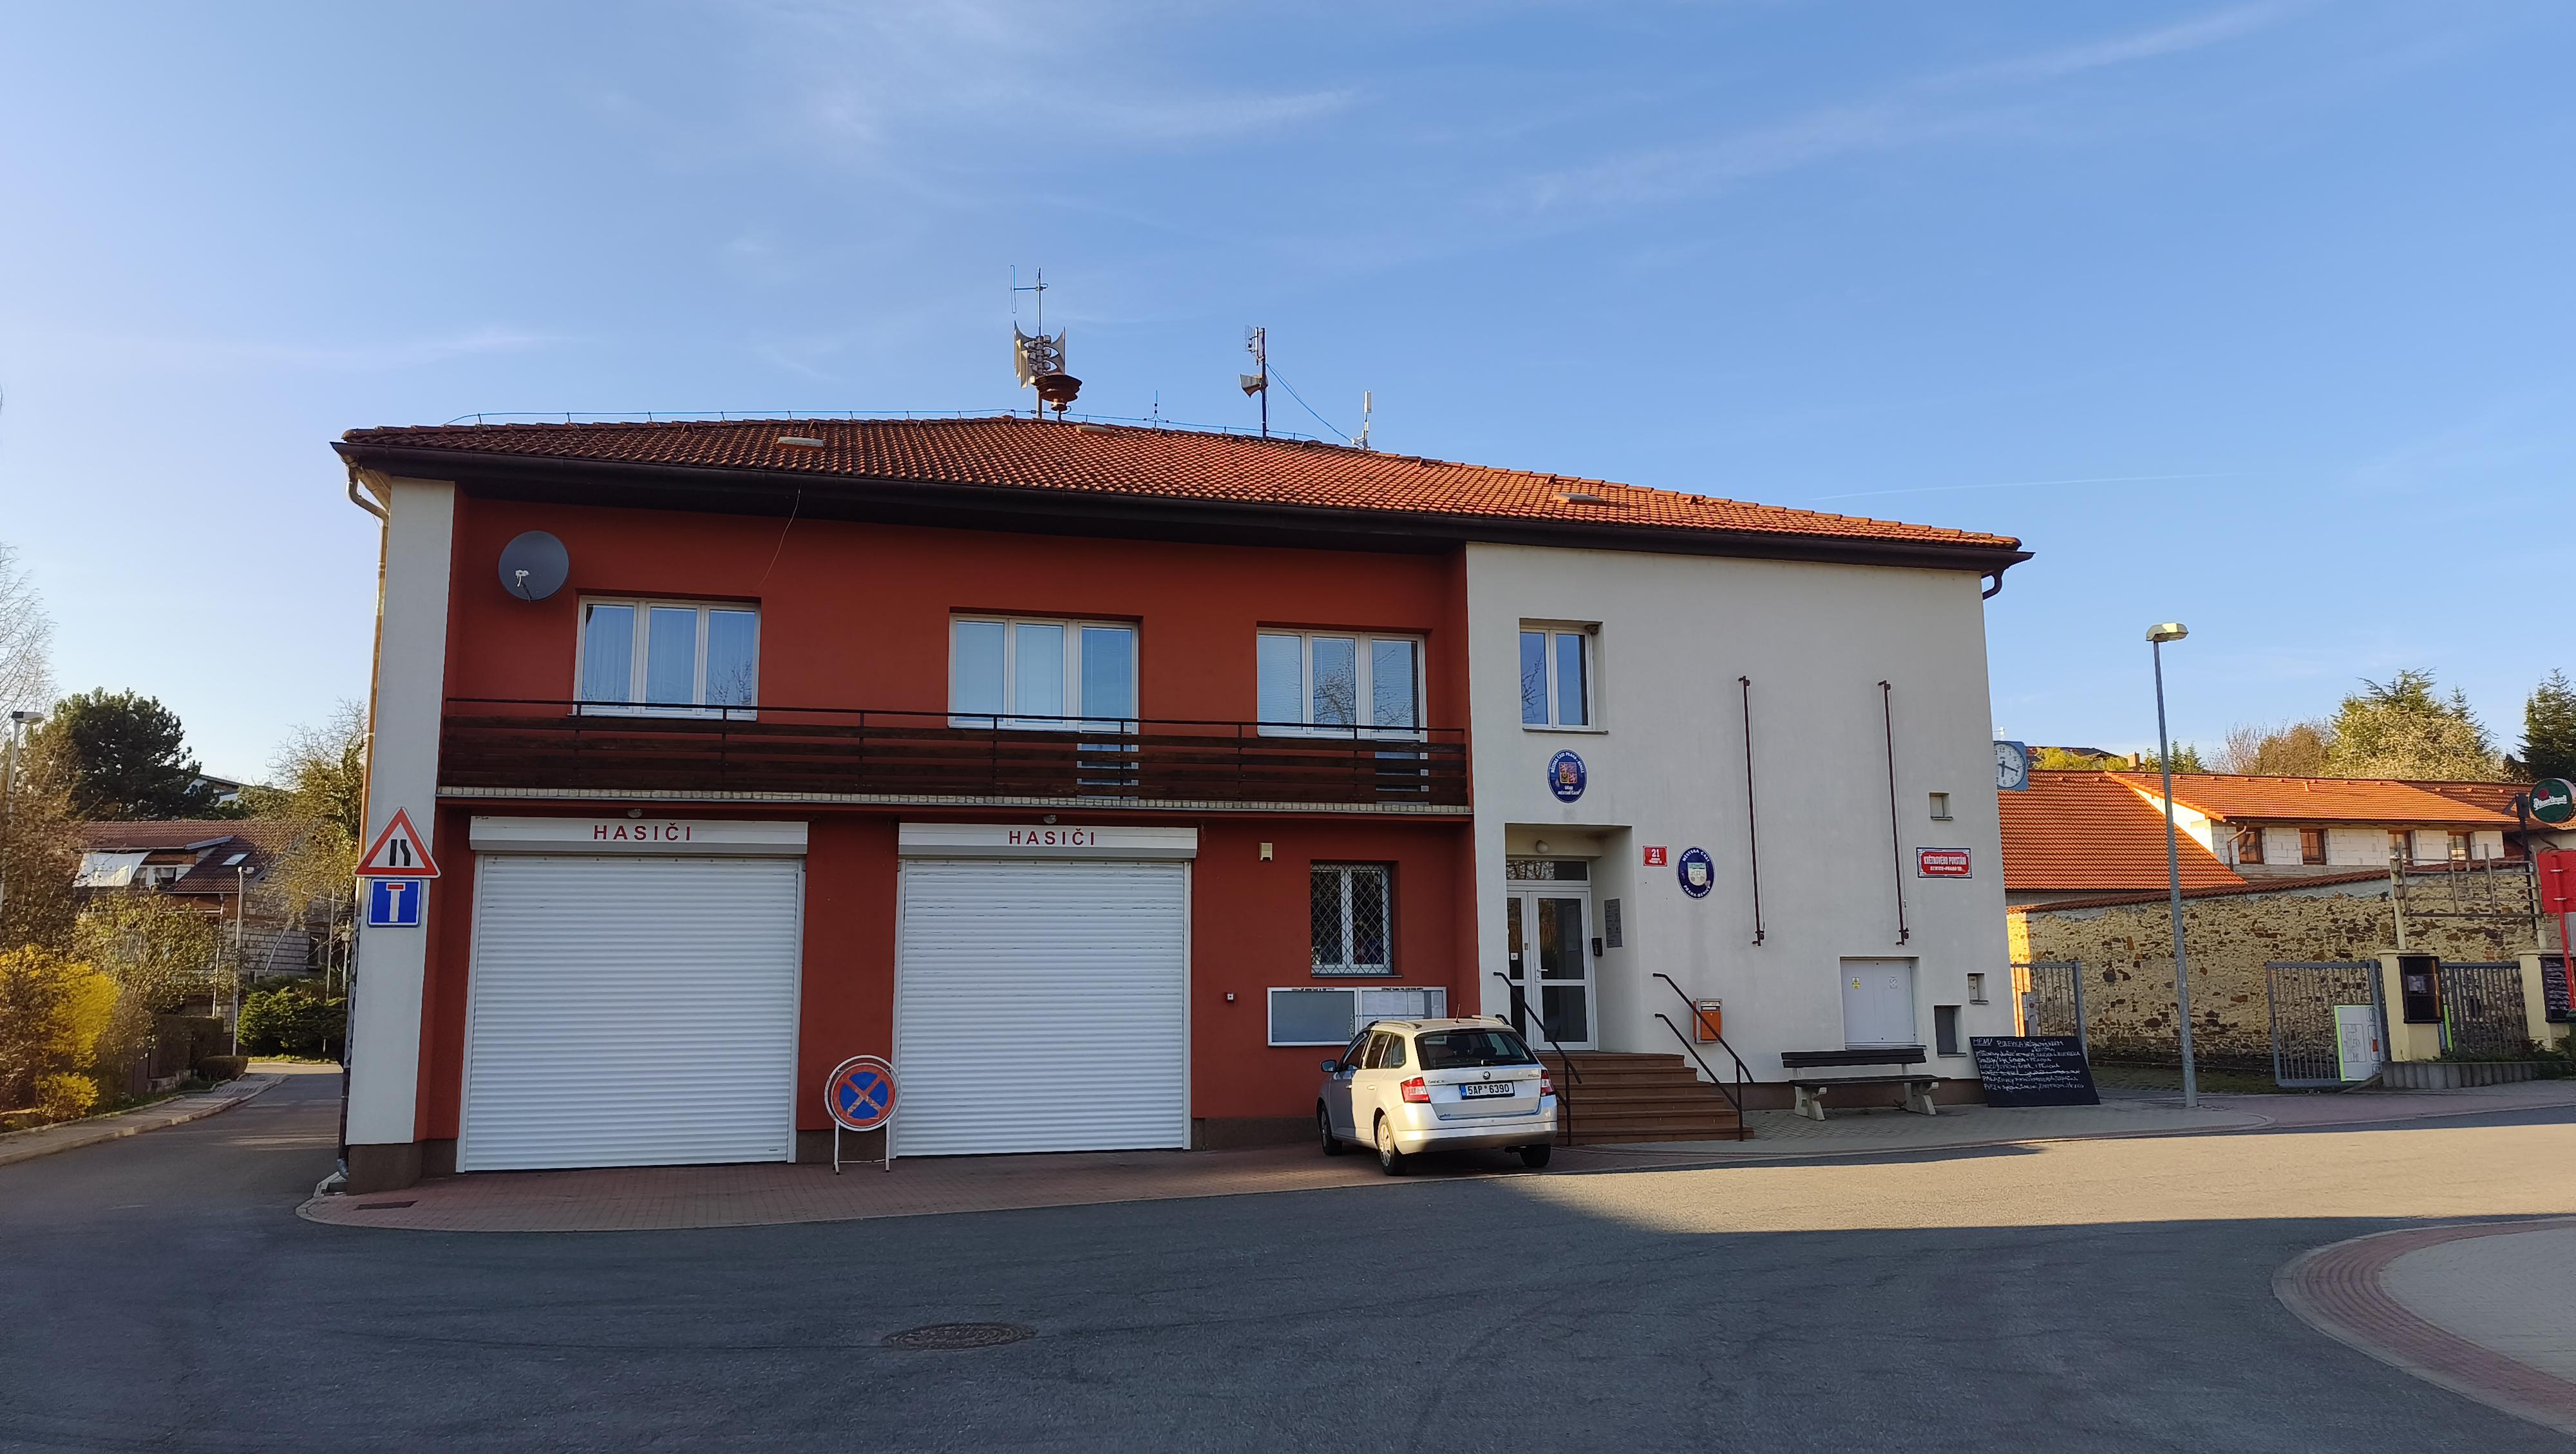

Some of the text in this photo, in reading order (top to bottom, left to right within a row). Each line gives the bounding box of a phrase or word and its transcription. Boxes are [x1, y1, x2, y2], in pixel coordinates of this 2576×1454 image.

[594, 822, 690, 841] HASIČI
[1009, 828, 1094, 845] HASIČI
[1651, 849, 1660, 858] 21
[1468, 1086, 1482, 1095] 5AP
[1489, 1084, 1510, 1093] 6390
